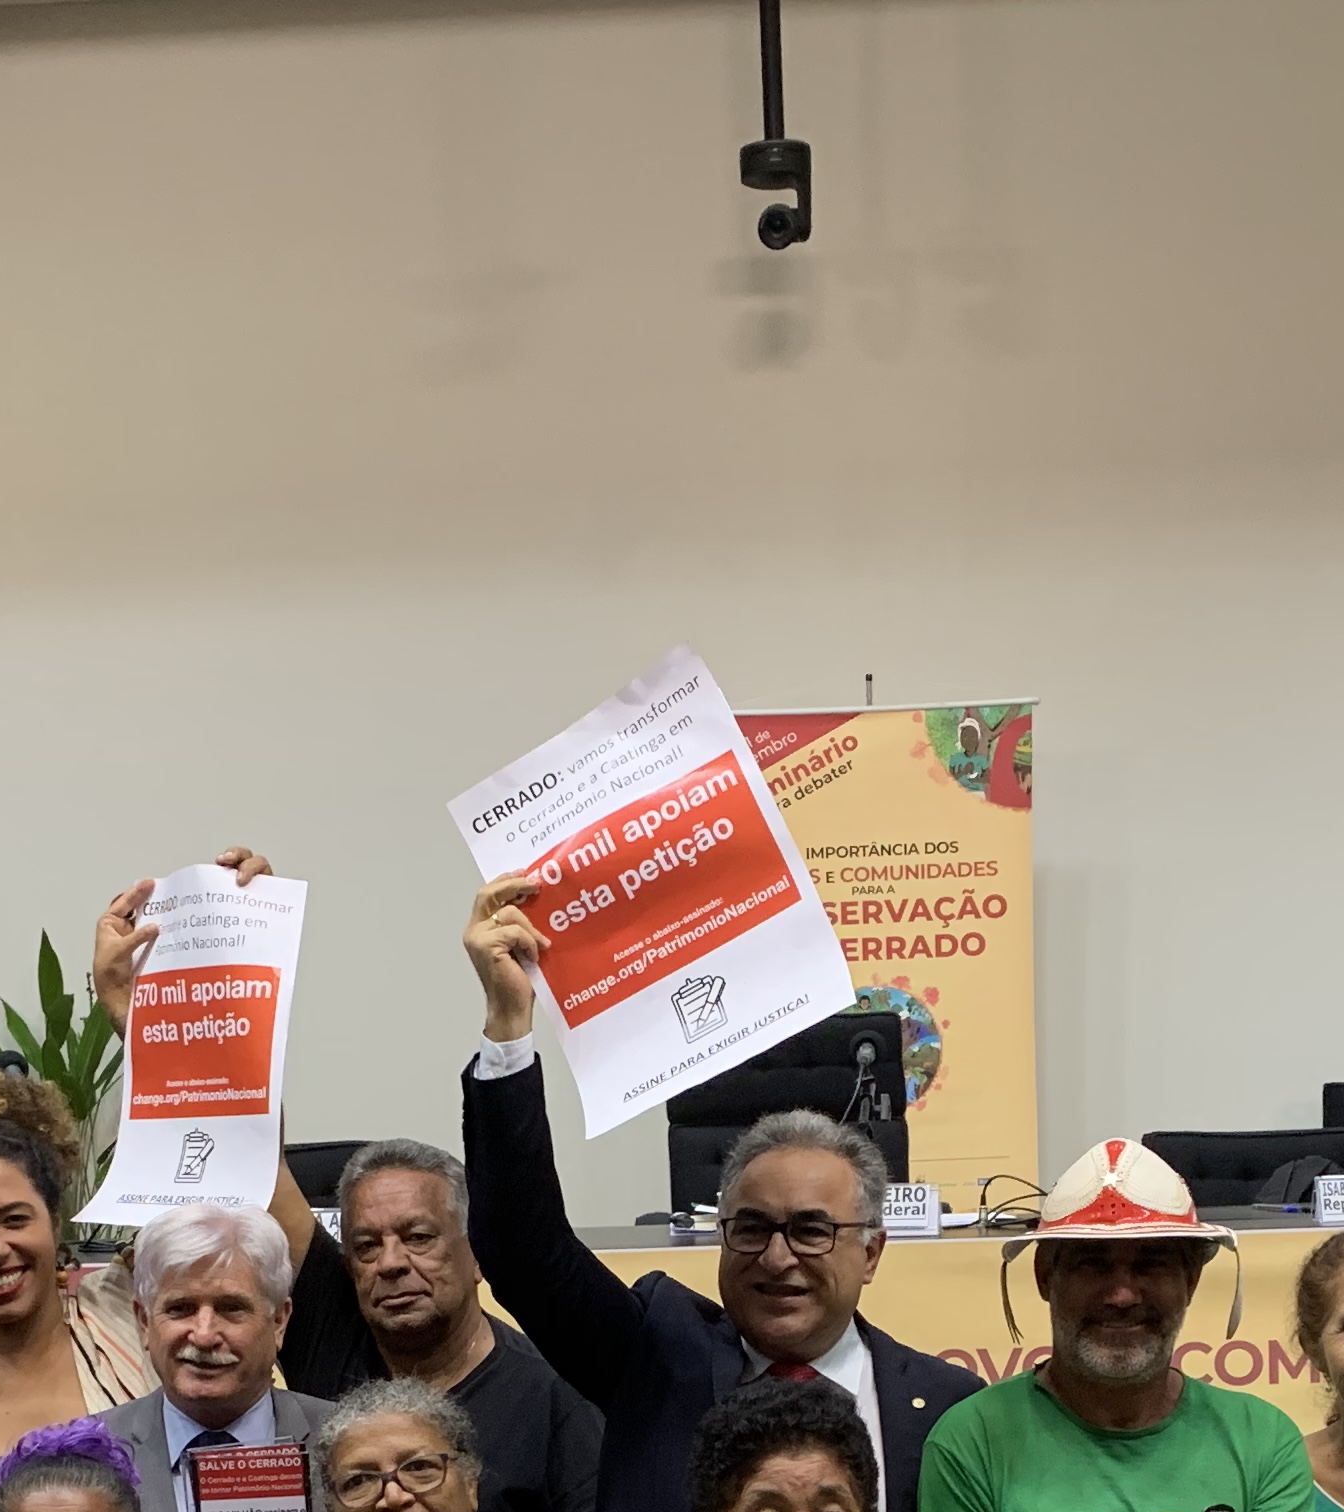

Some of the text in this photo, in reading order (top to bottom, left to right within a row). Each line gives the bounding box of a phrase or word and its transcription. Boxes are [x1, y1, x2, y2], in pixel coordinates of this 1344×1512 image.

[755, 730, 771, 744] de
[472, 675, 700, 834] CERRADO: vamos transformar
[506, 713, 693, 843] o Cerrado e a Caatinga em
[794, 760, 852, 800] debater
[531, 744, 685, 848] Patrimônio Nacional!
[567, 769, 738, 872] mil apoiam
[806, 841, 959, 859] IMPORTÂNCIA DOS
[548, 817, 734, 932] esta petição
[826, 872, 835, 883] E
[840, 861, 998, 882] COMUNIDADES
[206, 892, 294, 914] transformar
[851, 885, 895, 895] PARA A
[190, 912, 239, 928] Caatinga
[245, 918, 268, 929] em
[192, 934, 246, 949] Nacional!
[564, 875, 790, 1010] change.org/PatrimonioNacional
[613, 940, 644, 962] Acesse
[135, 975, 272, 1008] 570 mil apoiam
[143, 1012, 250, 1045] esta petição
[622, 994, 810, 1104] ASSINE PARA EXIGIR JUSTIÇA!
[884, 1203, 926, 1216] deral
[199, 1457, 301, 1471] SALVE O CERRADO
